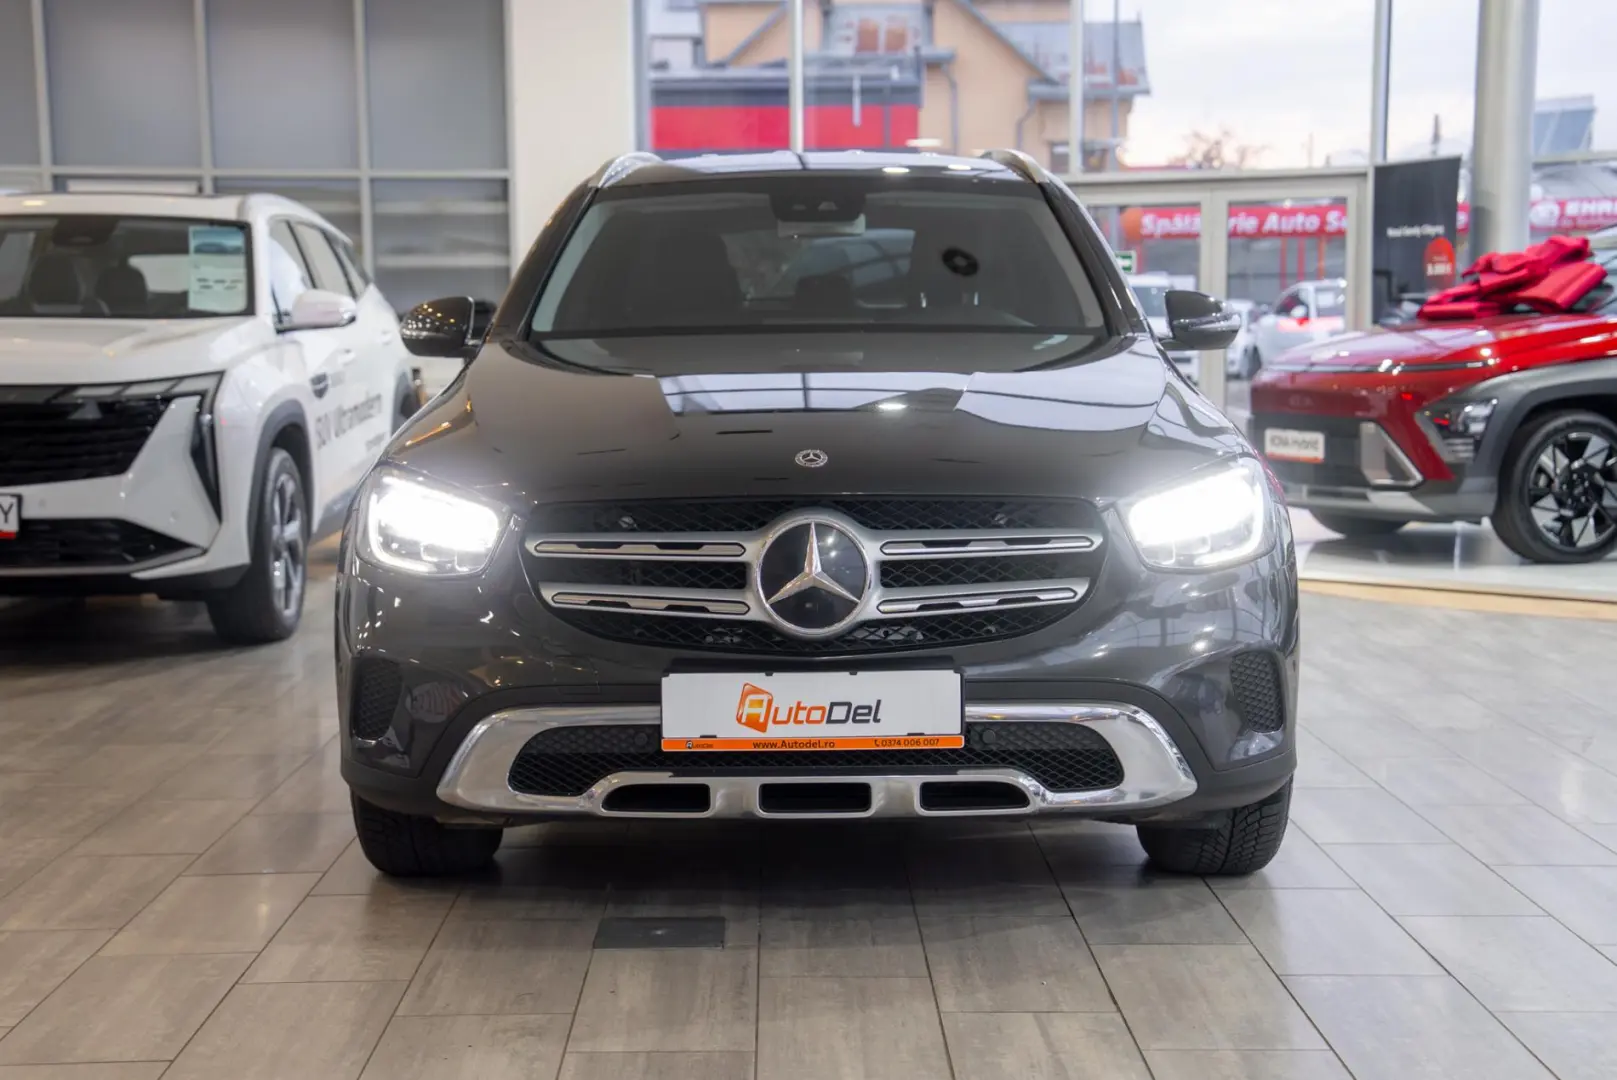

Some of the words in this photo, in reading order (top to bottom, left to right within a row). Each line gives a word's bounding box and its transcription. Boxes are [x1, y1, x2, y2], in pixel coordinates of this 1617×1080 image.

[1262, 211, 1321, 234] Auto
[738, 687, 882, 729] AutoDel
[752, 739, 835, 750] www.Autodel.ro
[881, 738, 902, 748] 0374
[903, 737, 921, 747] 006
[923, 737, 940, 746] 007
